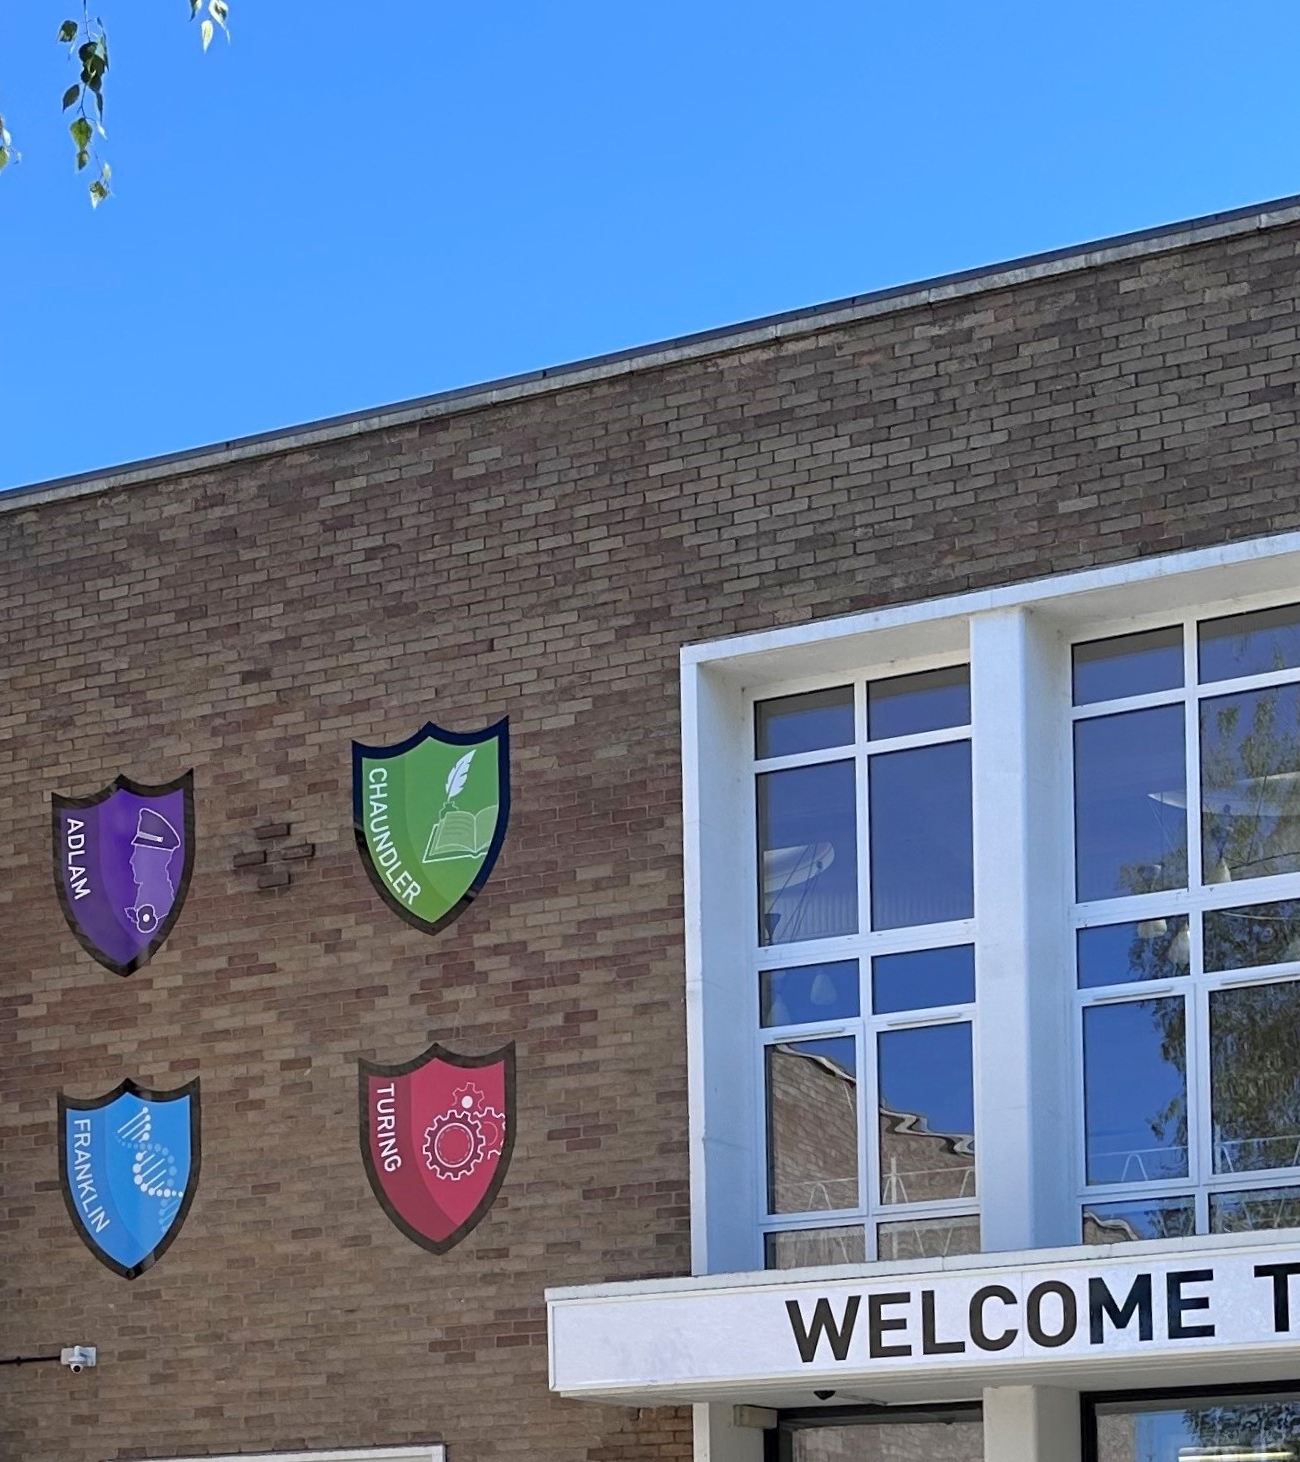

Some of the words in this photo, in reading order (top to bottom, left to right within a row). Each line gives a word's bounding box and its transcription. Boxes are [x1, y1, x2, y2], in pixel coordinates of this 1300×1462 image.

[67, 818, 92, 900] ADLAM
[368, 767, 422, 906] CHAUNDLER
[376, 1082, 403, 1173] TURING
[73, 1118, 111, 1234] FRANKLIN
[785, 1268, 1216, 1364] WELCOME
